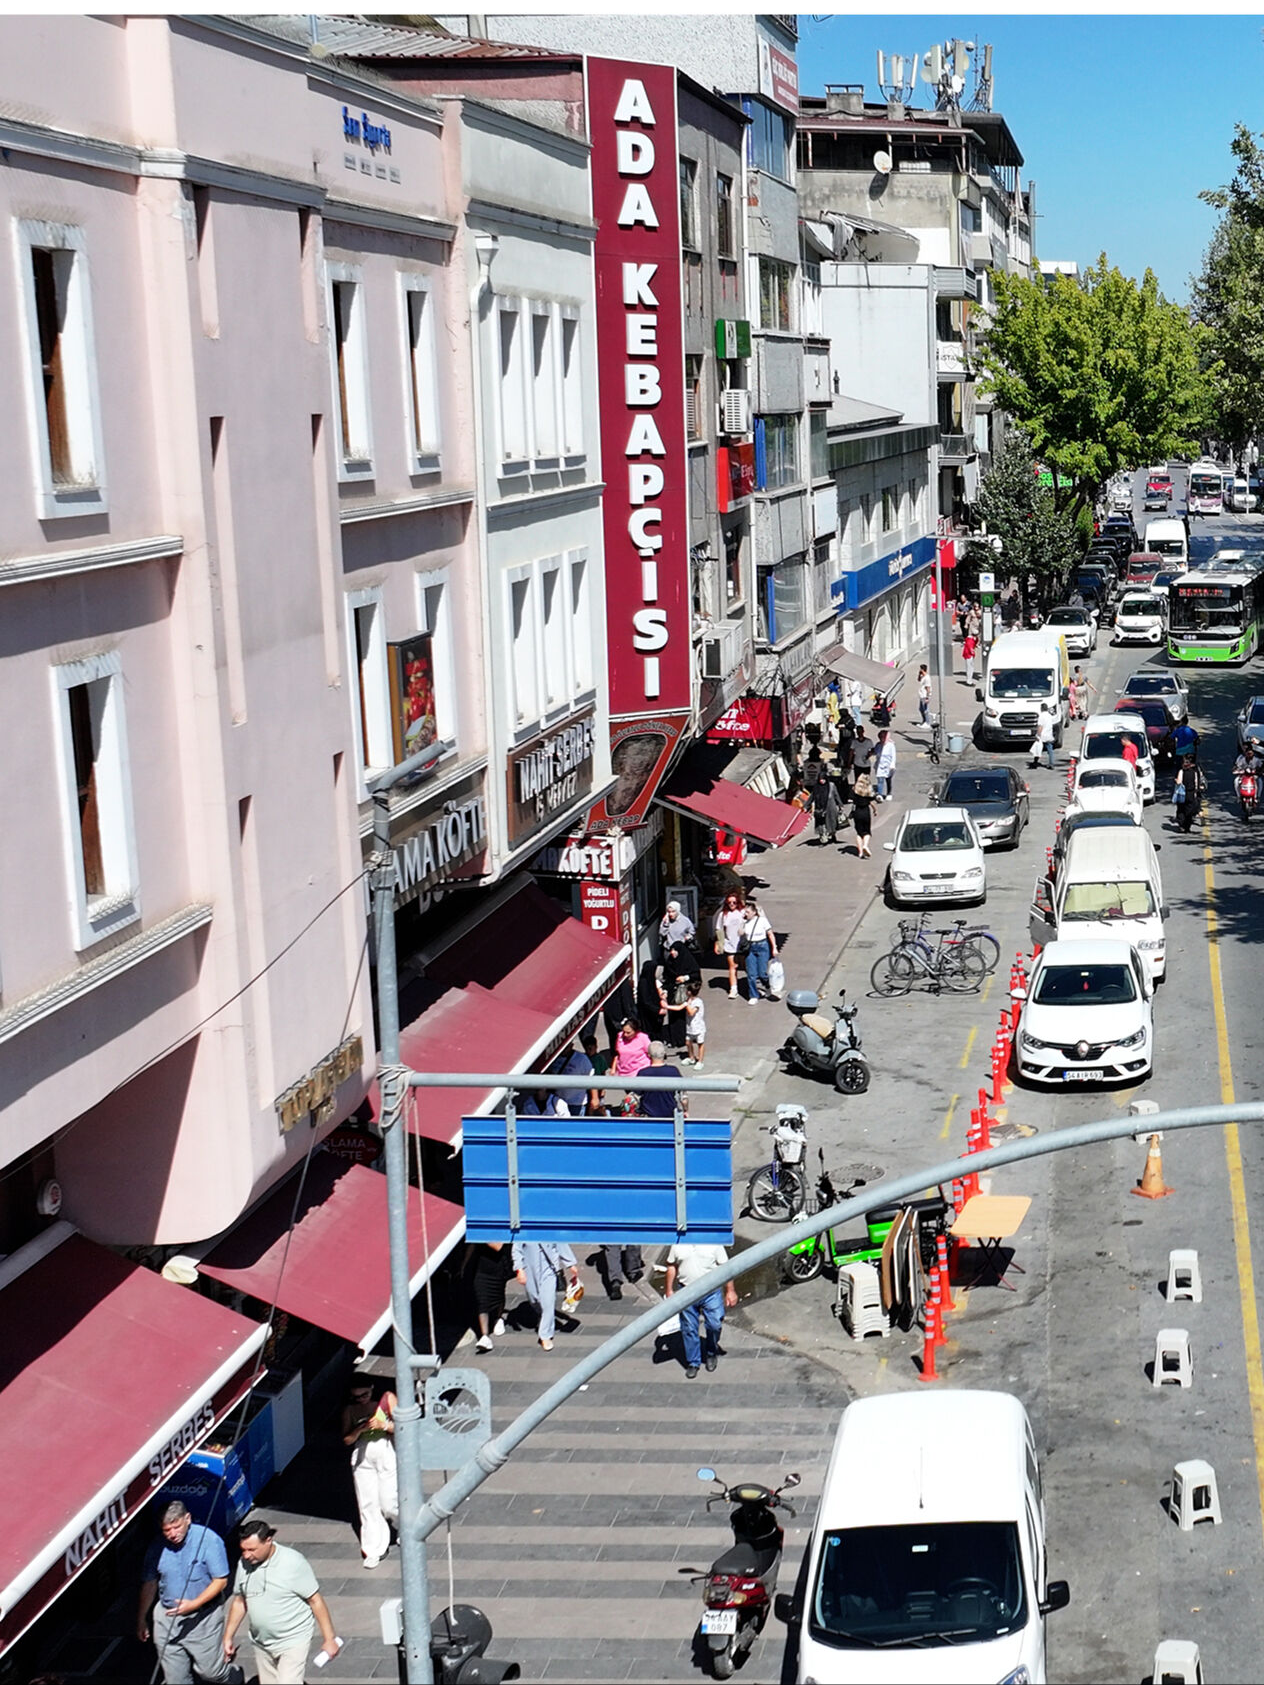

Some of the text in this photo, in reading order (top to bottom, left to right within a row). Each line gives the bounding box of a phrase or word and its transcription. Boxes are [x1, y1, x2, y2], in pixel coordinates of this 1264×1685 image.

[613, 77, 659, 228] ADA
[557, 841, 613, 875] KÖFTE
[149, 1398, 216, 1487] SERBES
